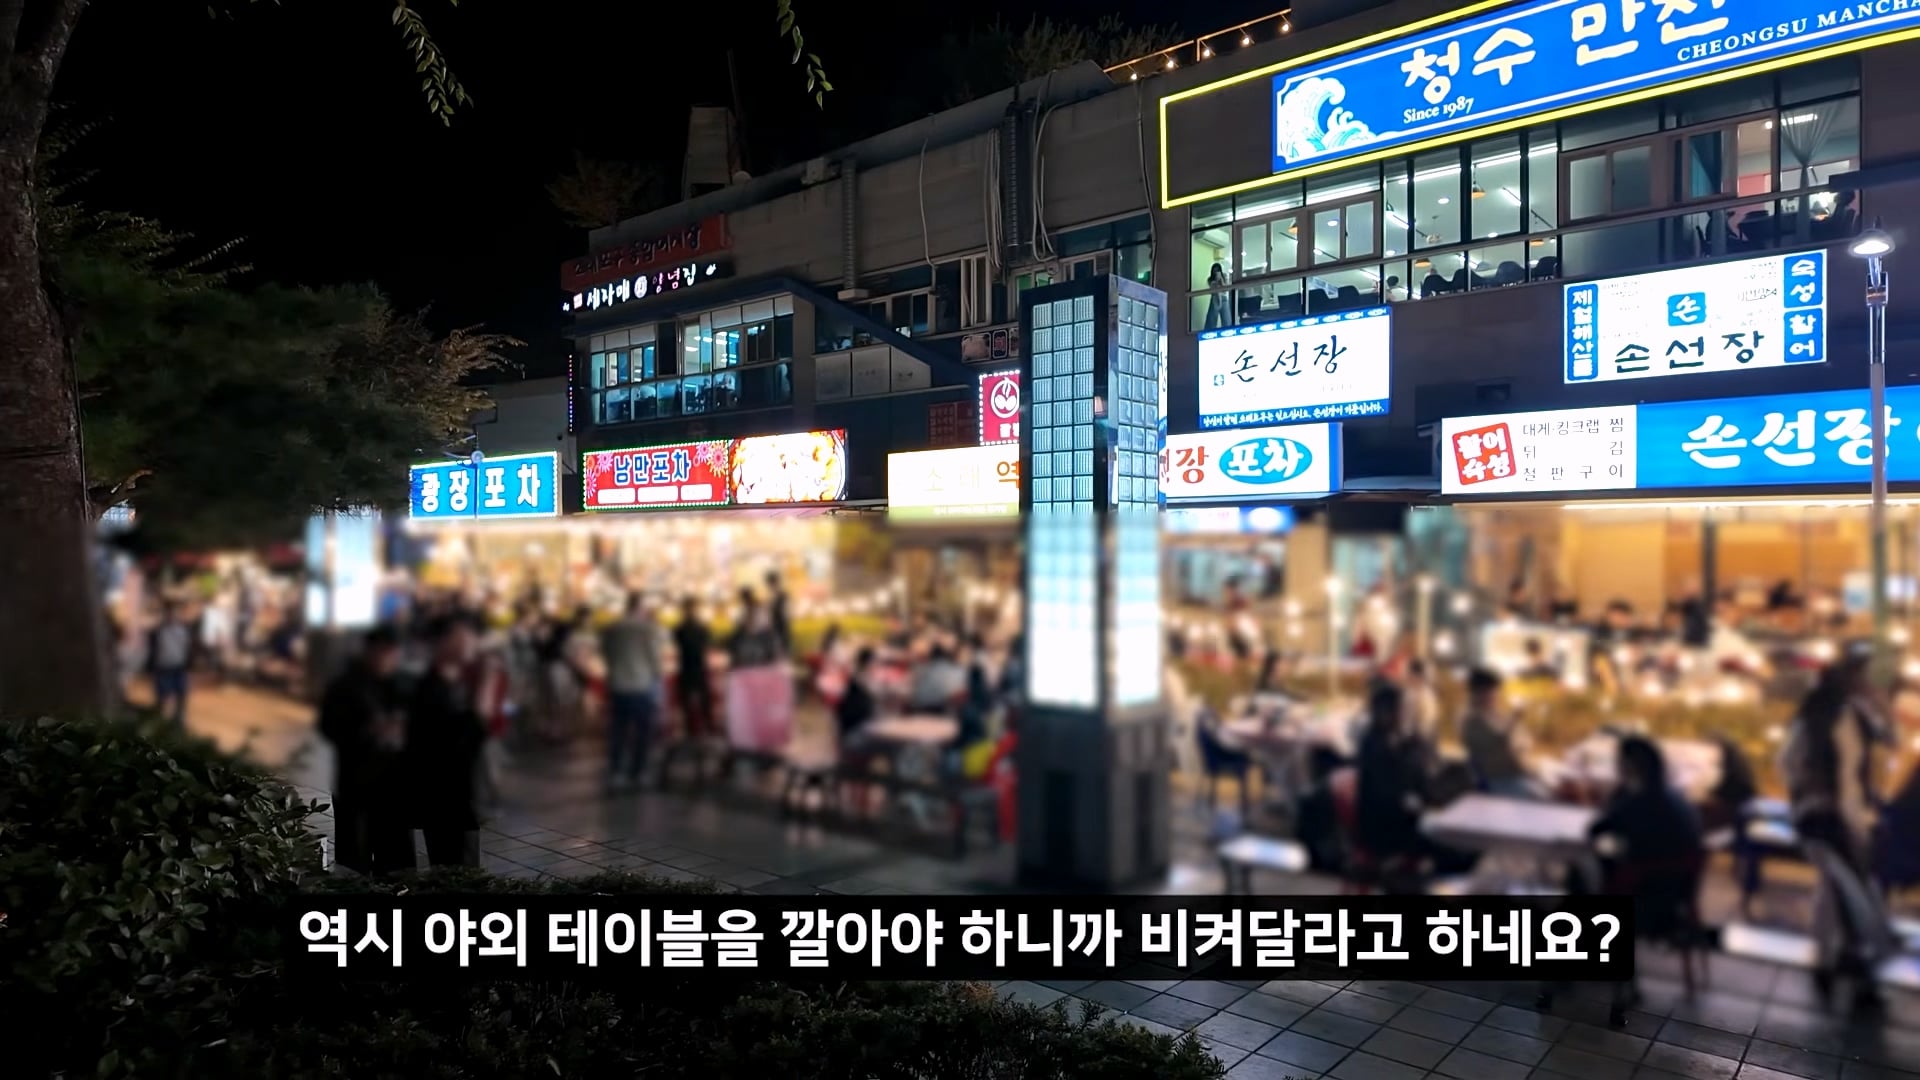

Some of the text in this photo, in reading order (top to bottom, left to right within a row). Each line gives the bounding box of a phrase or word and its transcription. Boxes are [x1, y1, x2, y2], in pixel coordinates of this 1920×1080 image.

[1677, 0, 1920, 62] CHEONGSU MANCH
[1401, 28, 1536, 104] 청수
[1403, 96, 1475, 124] Since 1987
[586, 278, 631, 311] 세자매
[1672, 296, 1702, 323] 손
[1230, 334, 1348, 383] 손선장
[1614, 330, 1765, 374] 손선장
[1457, 428, 1507, 460] 활어
[1609, 417, 1624, 433] 찜
[1681, 404, 1902, 469] 손선장
[614, 449, 691, 485] 남만포차
[1227, 438, 1305, 479] 포차
[1462, 451, 1511, 482] 숙성
[420, 463, 541, 513] 광장포차
